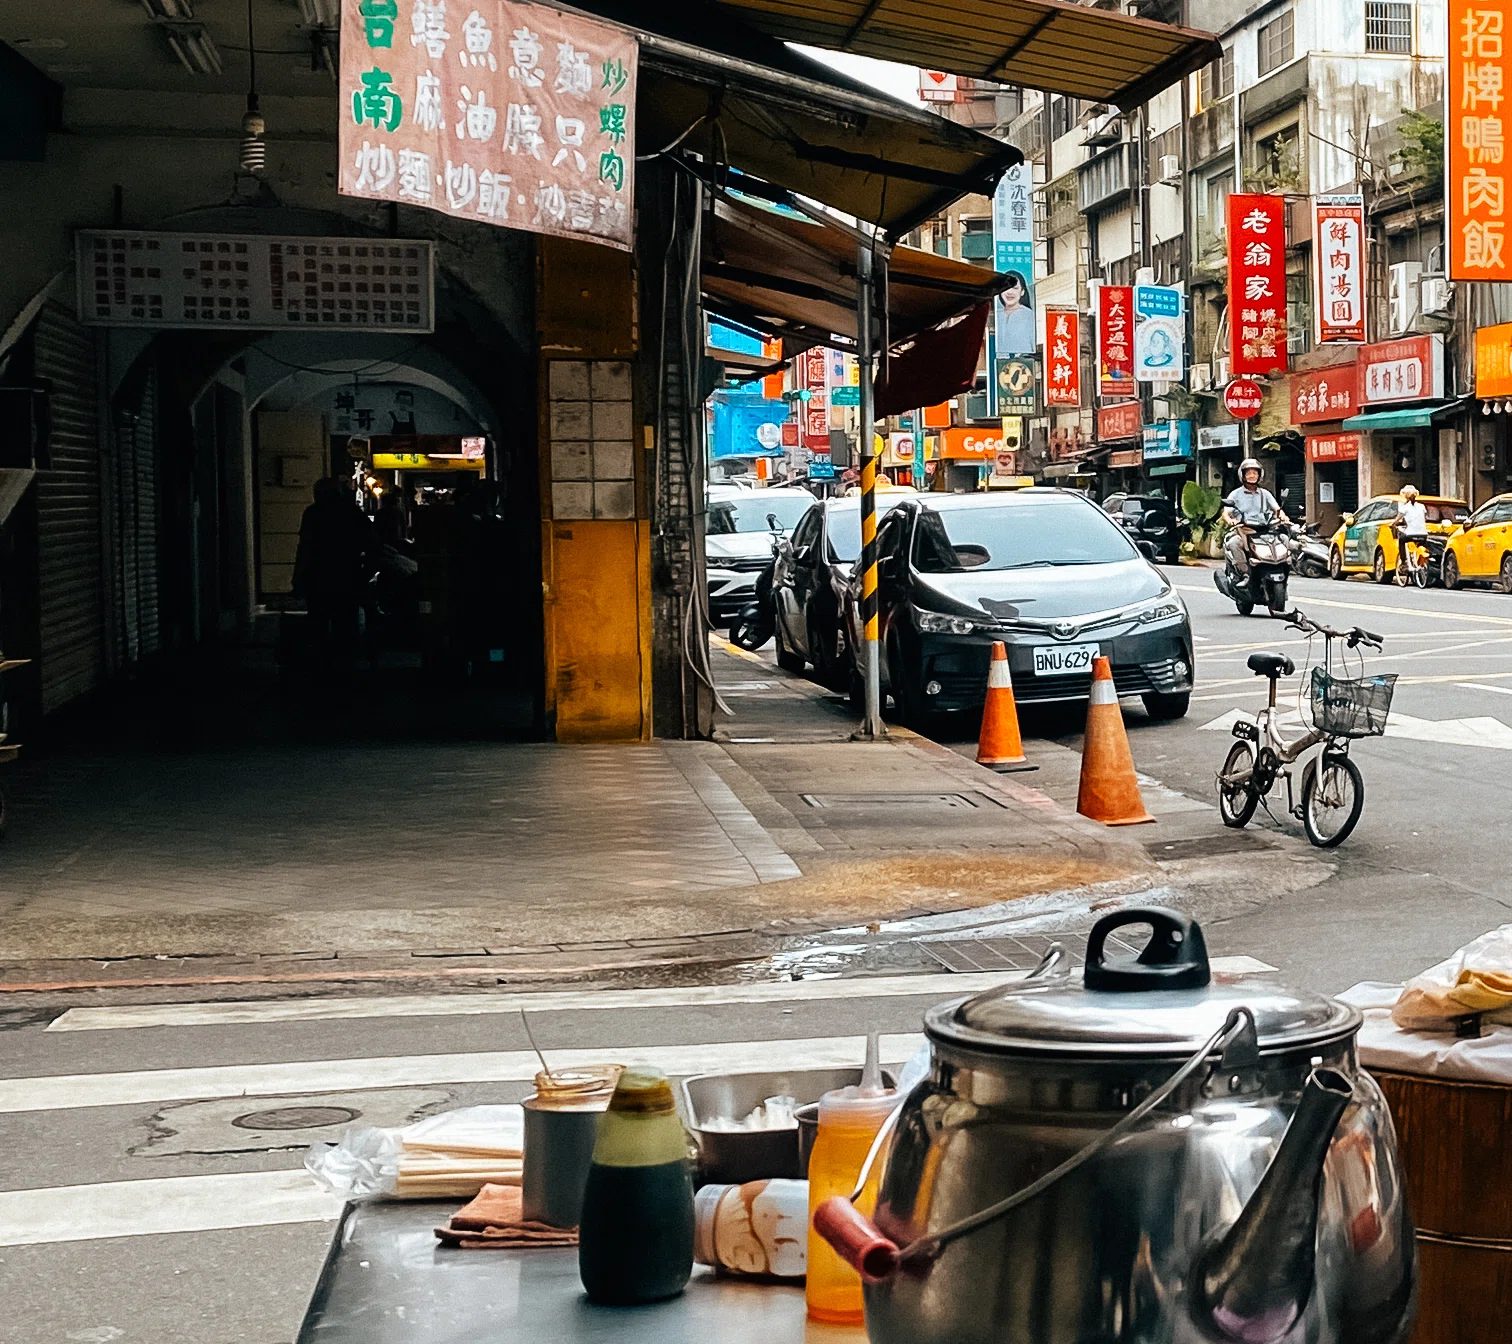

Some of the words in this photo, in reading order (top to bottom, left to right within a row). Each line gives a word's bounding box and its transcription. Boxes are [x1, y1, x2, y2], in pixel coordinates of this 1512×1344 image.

[1460, 7, 1505, 271] 招牌鴨肉飯
[1241, 208, 1274, 301] 老翁家
[1329, 222, 1352, 322] 鮮肉湯圓
